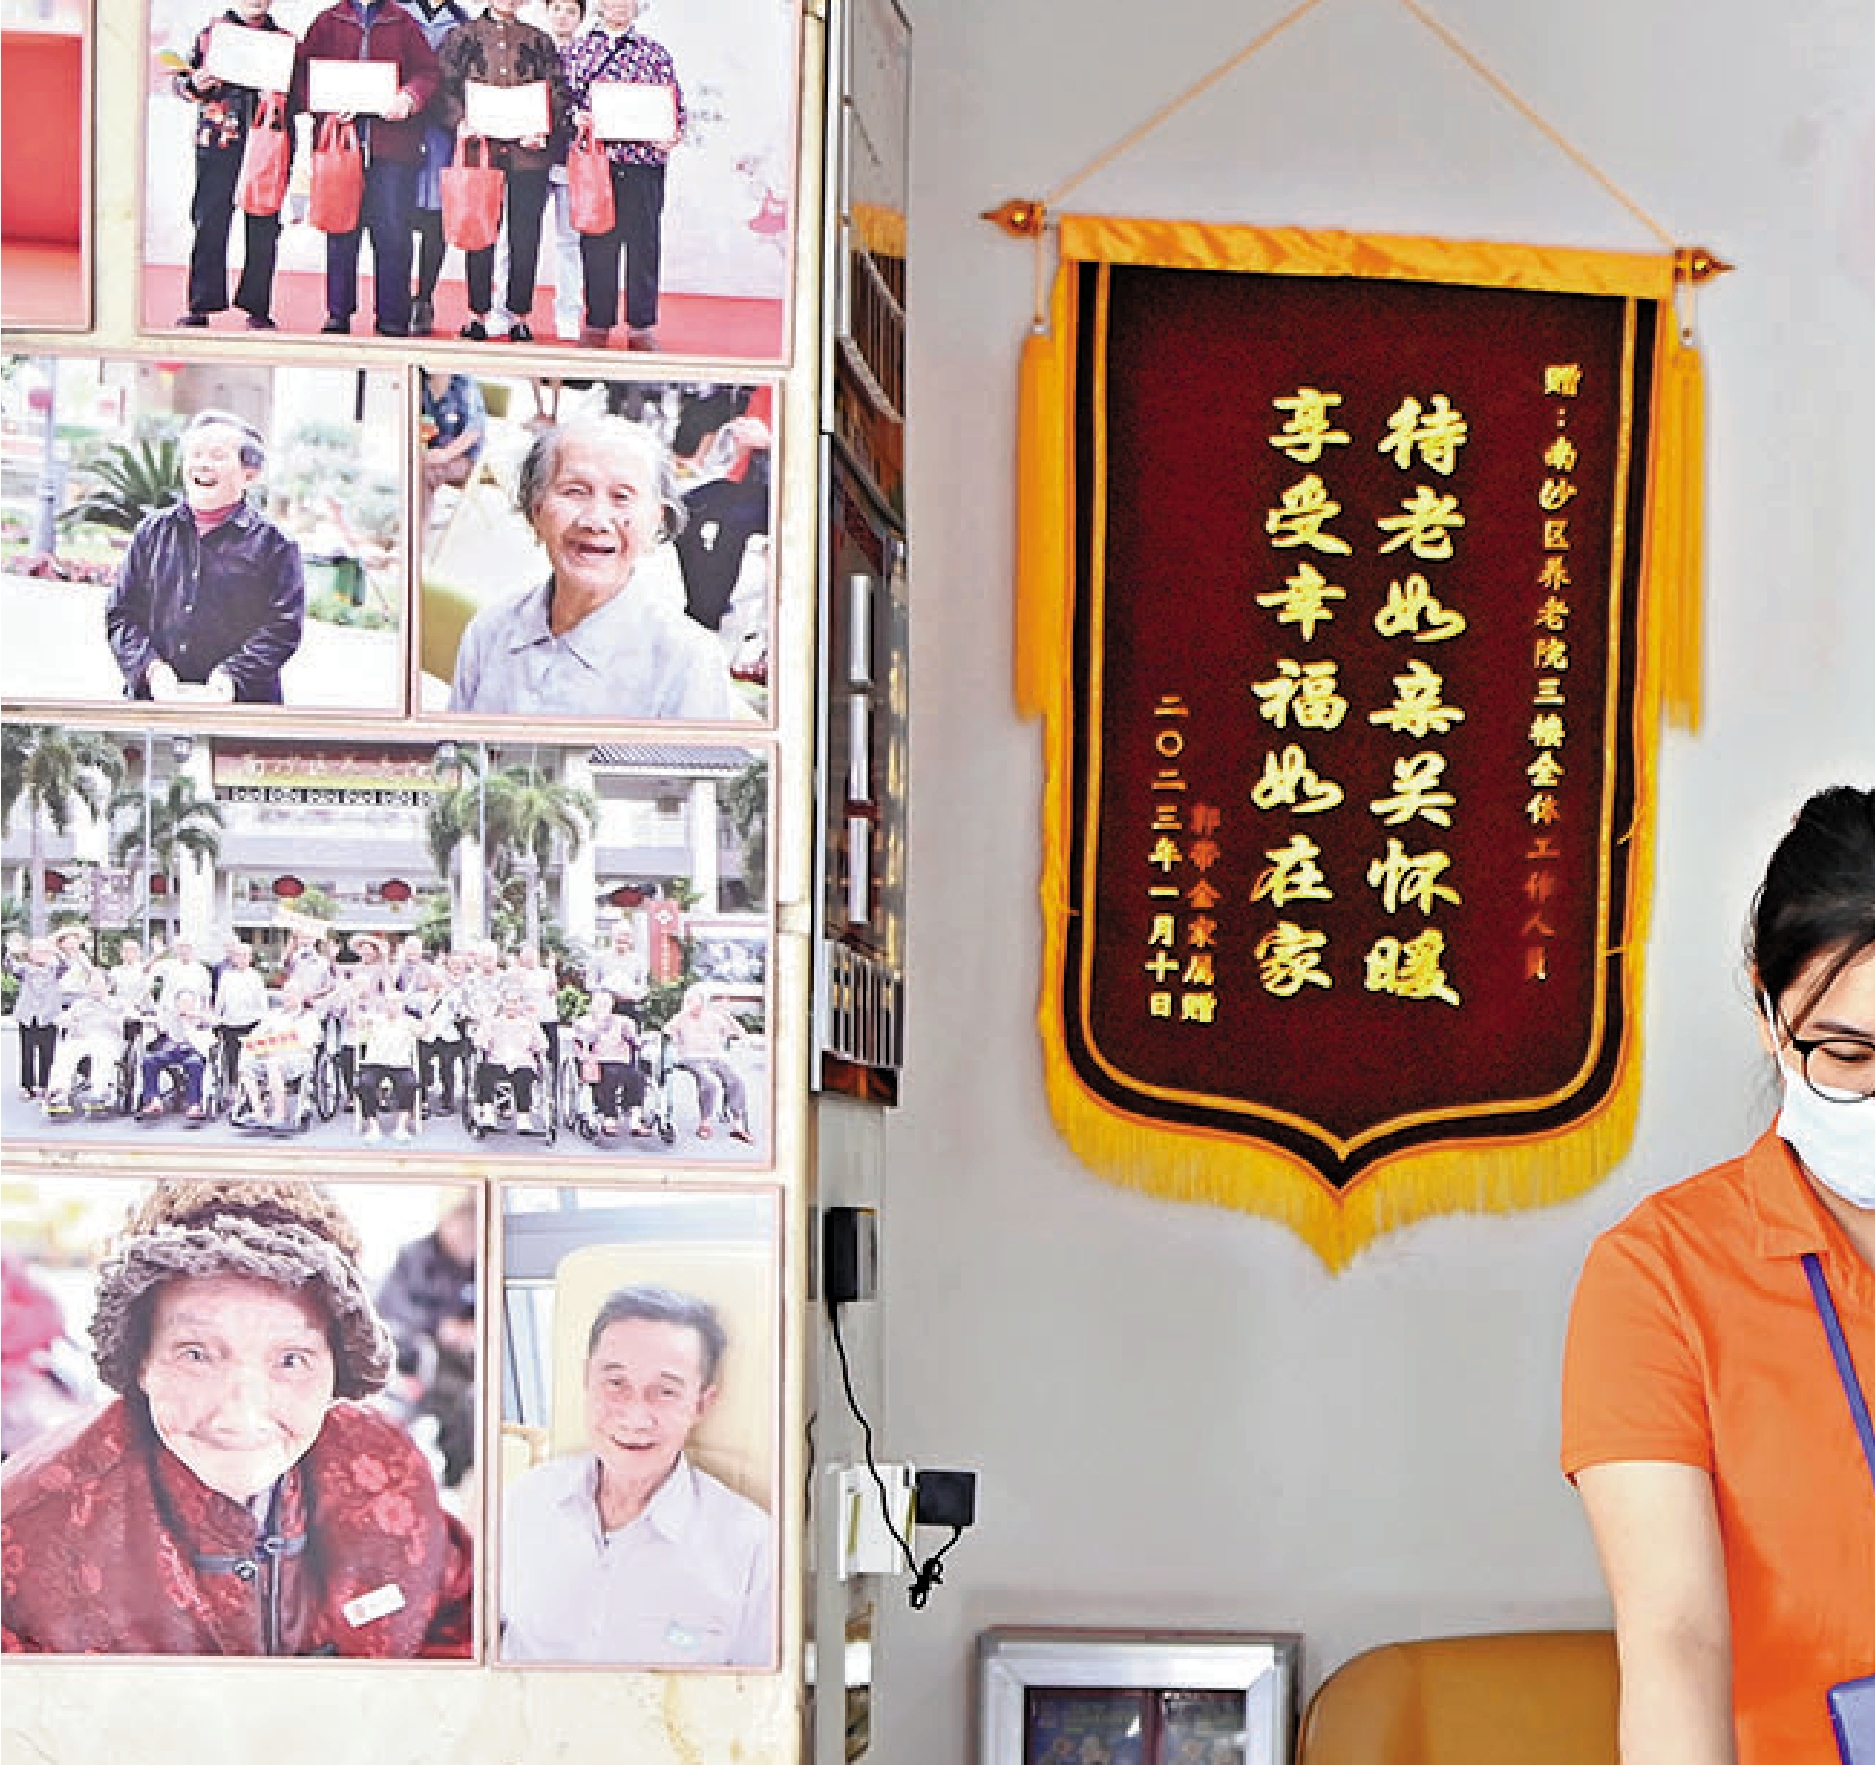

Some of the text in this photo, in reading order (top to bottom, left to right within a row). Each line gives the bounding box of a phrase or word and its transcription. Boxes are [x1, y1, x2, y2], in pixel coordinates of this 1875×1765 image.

[1251, 387, 1352, 998] 享受幸福如在家
[1365, 394, 1468, 1006] 待老如亲关怀暖
